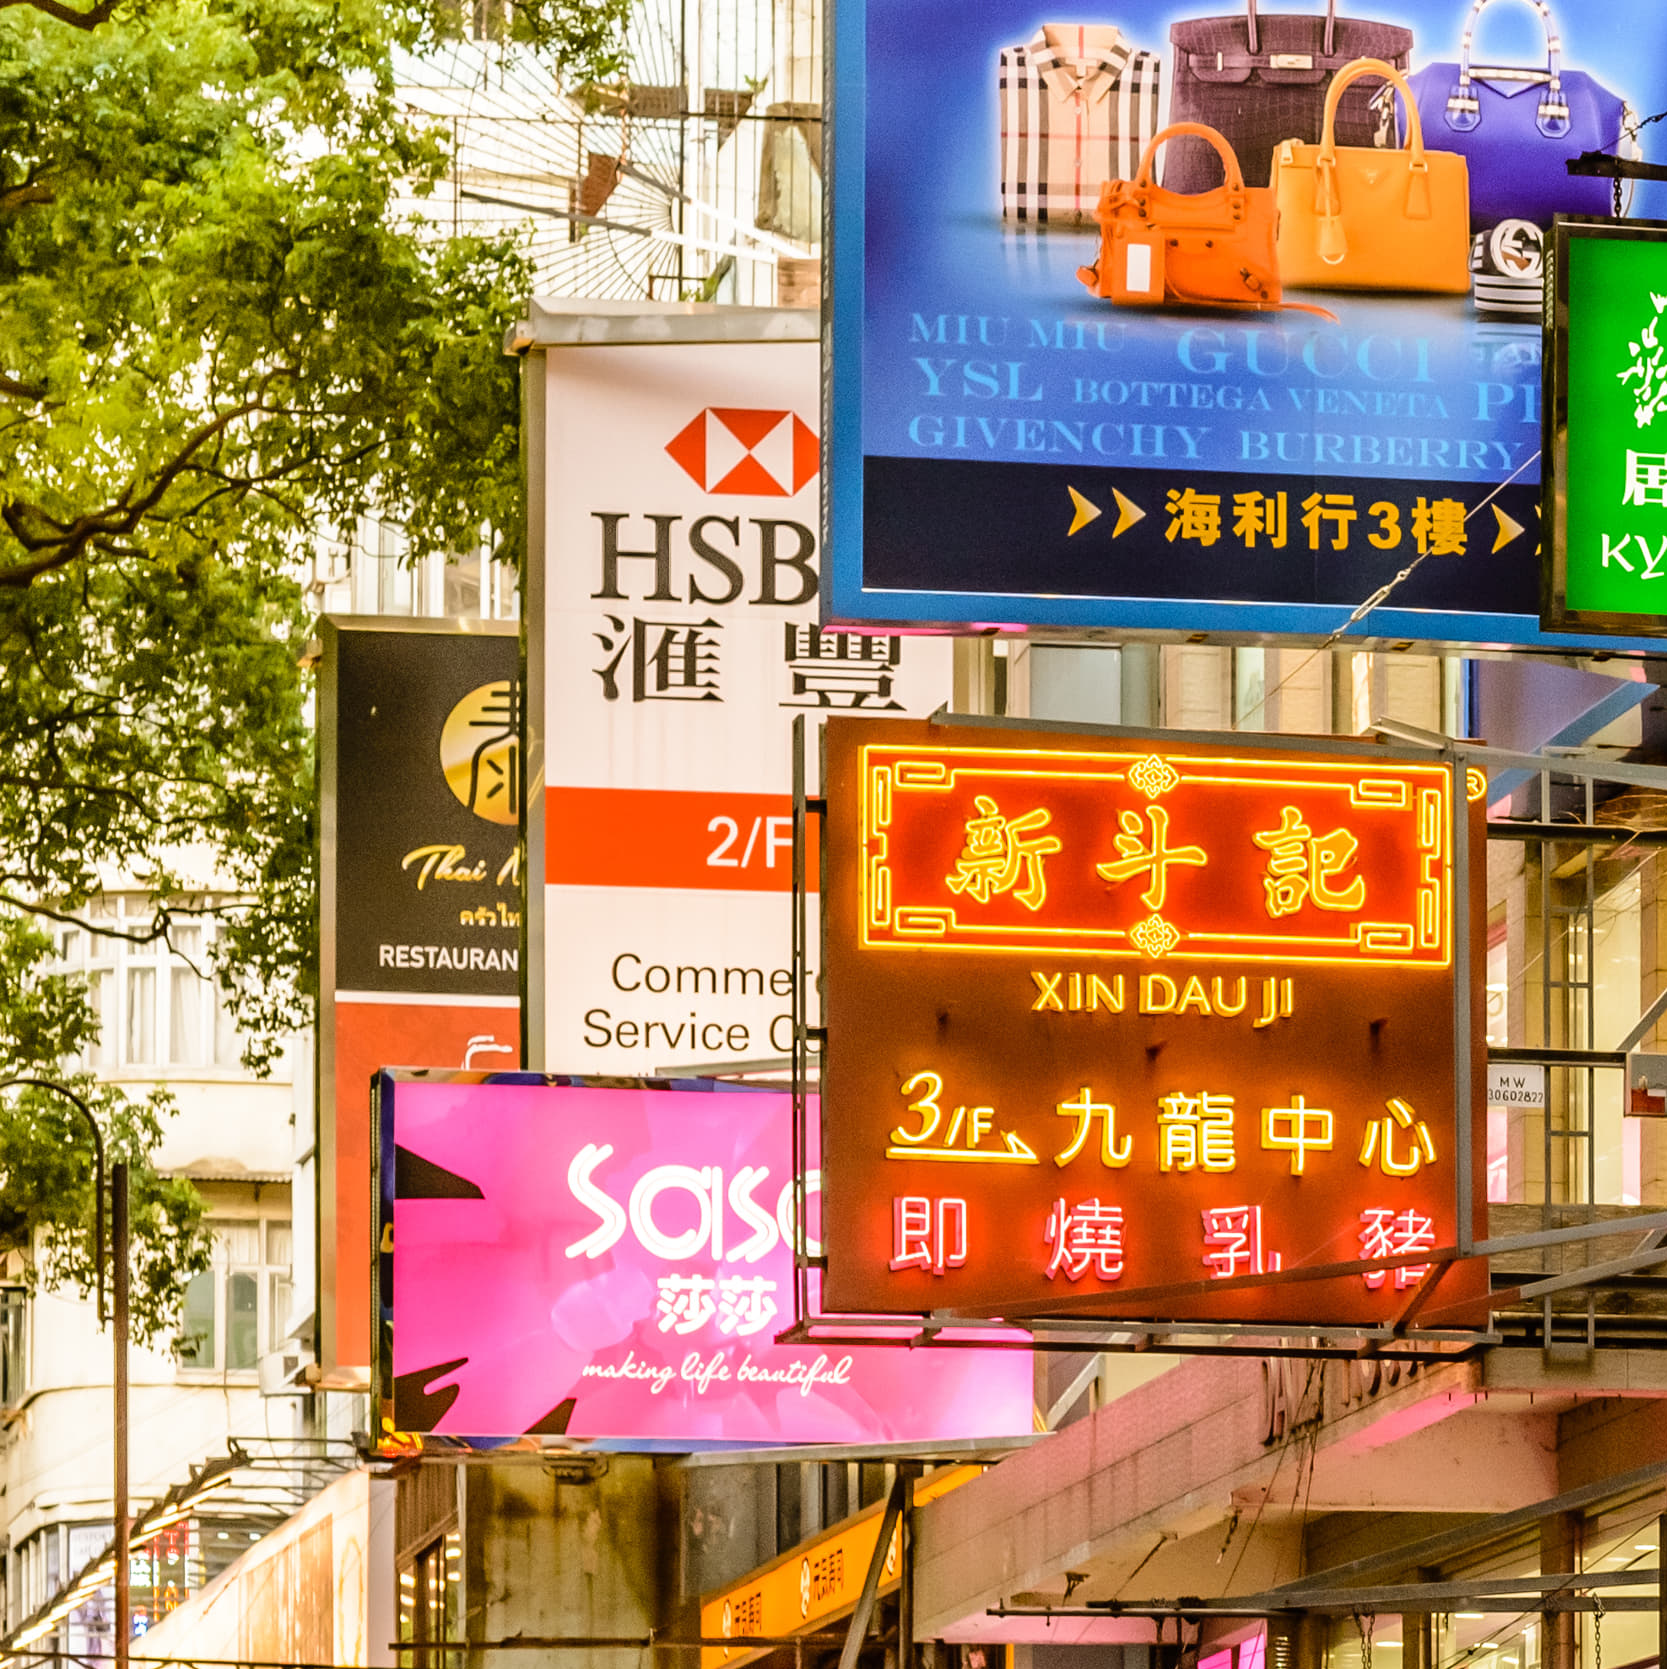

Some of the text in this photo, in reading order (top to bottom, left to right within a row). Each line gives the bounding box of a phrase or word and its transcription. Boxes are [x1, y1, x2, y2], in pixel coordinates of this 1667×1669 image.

[909, 312, 1431, 382] MIU MIU GUCCI
[914, 357, 1448, 420] YSL BOTTEGA VENETA
[909, 415, 1524, 471] GIVENCHY BURBERRY
[1164, 488, 1468, 556] 海利行3樓
[402, 845, 487, 890] Thai
[946, 794, 1366, 918] 新斗記
[380, 945, 518, 971] RESTAURAN
[1030, 971, 1293, 1028] XIN DAU JI
[584, 1009, 749, 1053] Service
[1054, 1087, 1437, 1177] 九龍中心
[656, 1273, 776, 1336] 莎莎
[582, 1351, 852, 1396] making life beautiful
